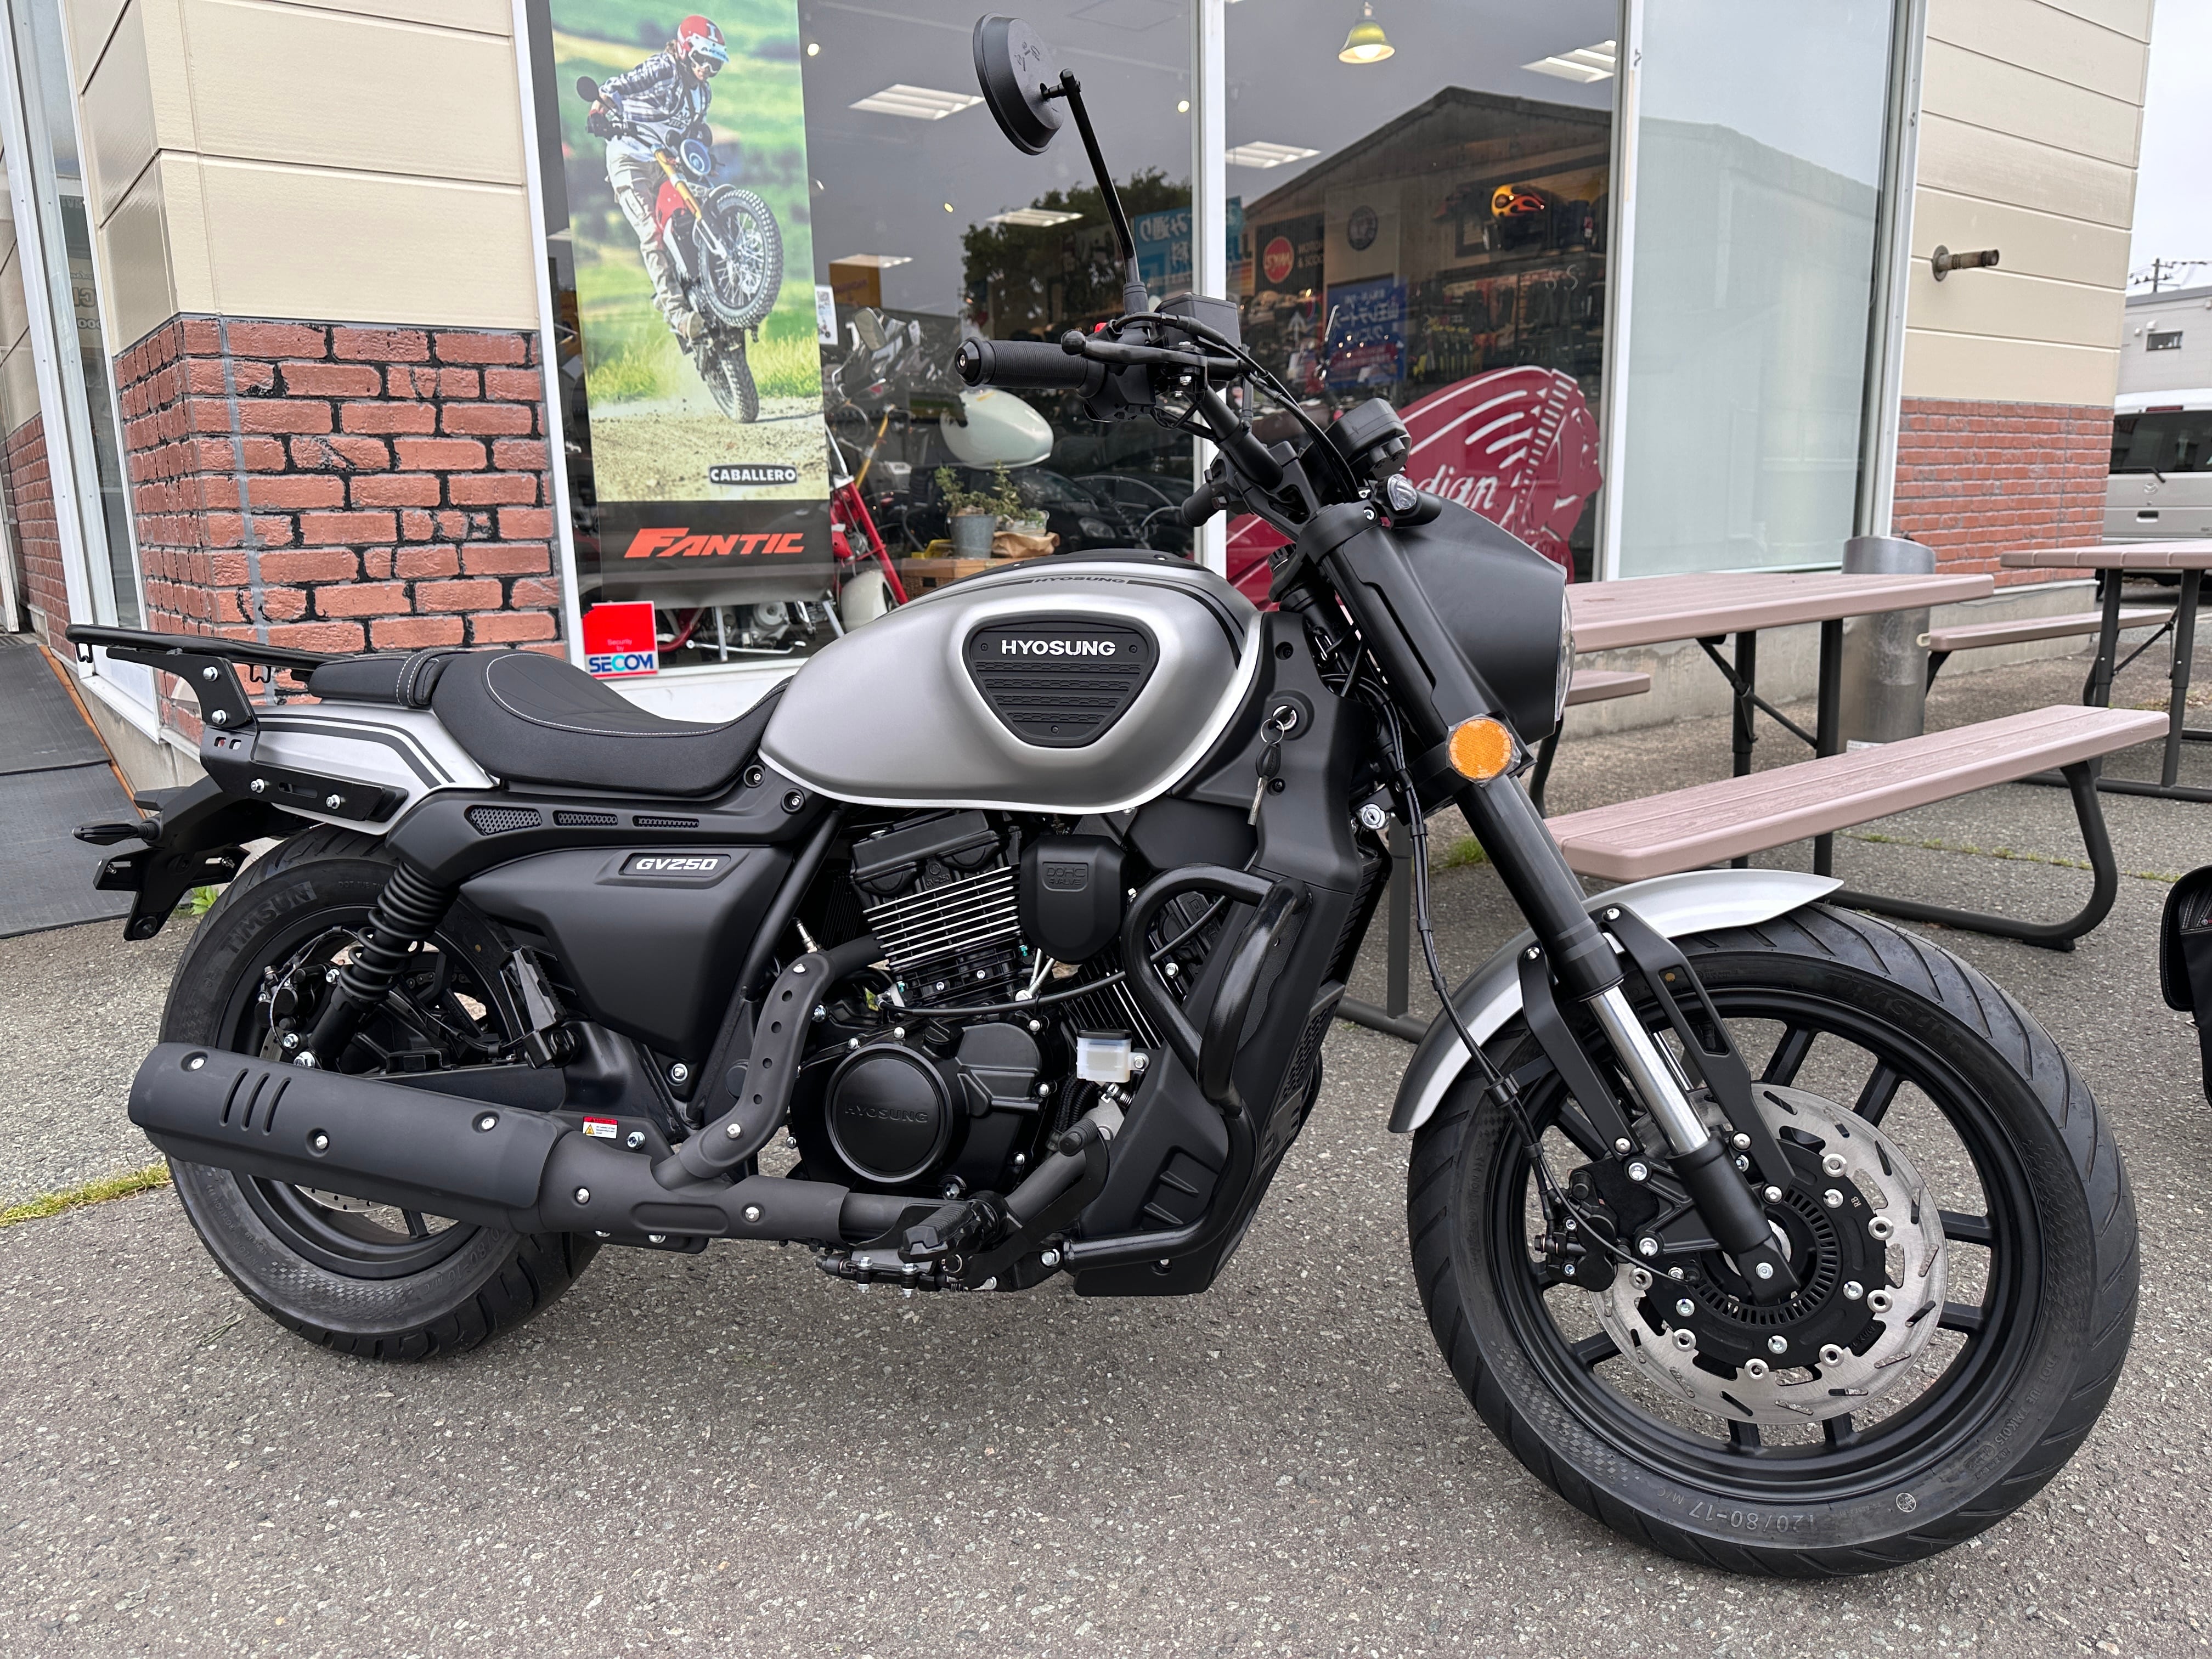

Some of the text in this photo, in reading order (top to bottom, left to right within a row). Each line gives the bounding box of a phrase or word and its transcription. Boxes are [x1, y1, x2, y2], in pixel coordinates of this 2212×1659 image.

[710, 466, 797, 482] CABALLERO
[1408, 464, 1499, 510] dian
[624, 527, 804, 558] FANTIC
[1035, 576, 1127, 584] HYOSUNG
[1001, 639, 1116, 656] HYOSUNG
[589, 653, 653, 673] SECOM
[635, 857, 719, 871] GV250
[1046, 866, 1088, 878] DOHC
[845, 1103, 929, 1124] HYOSUNG
[1656, 1486, 1818, 1533] 120/80-17 M/C
